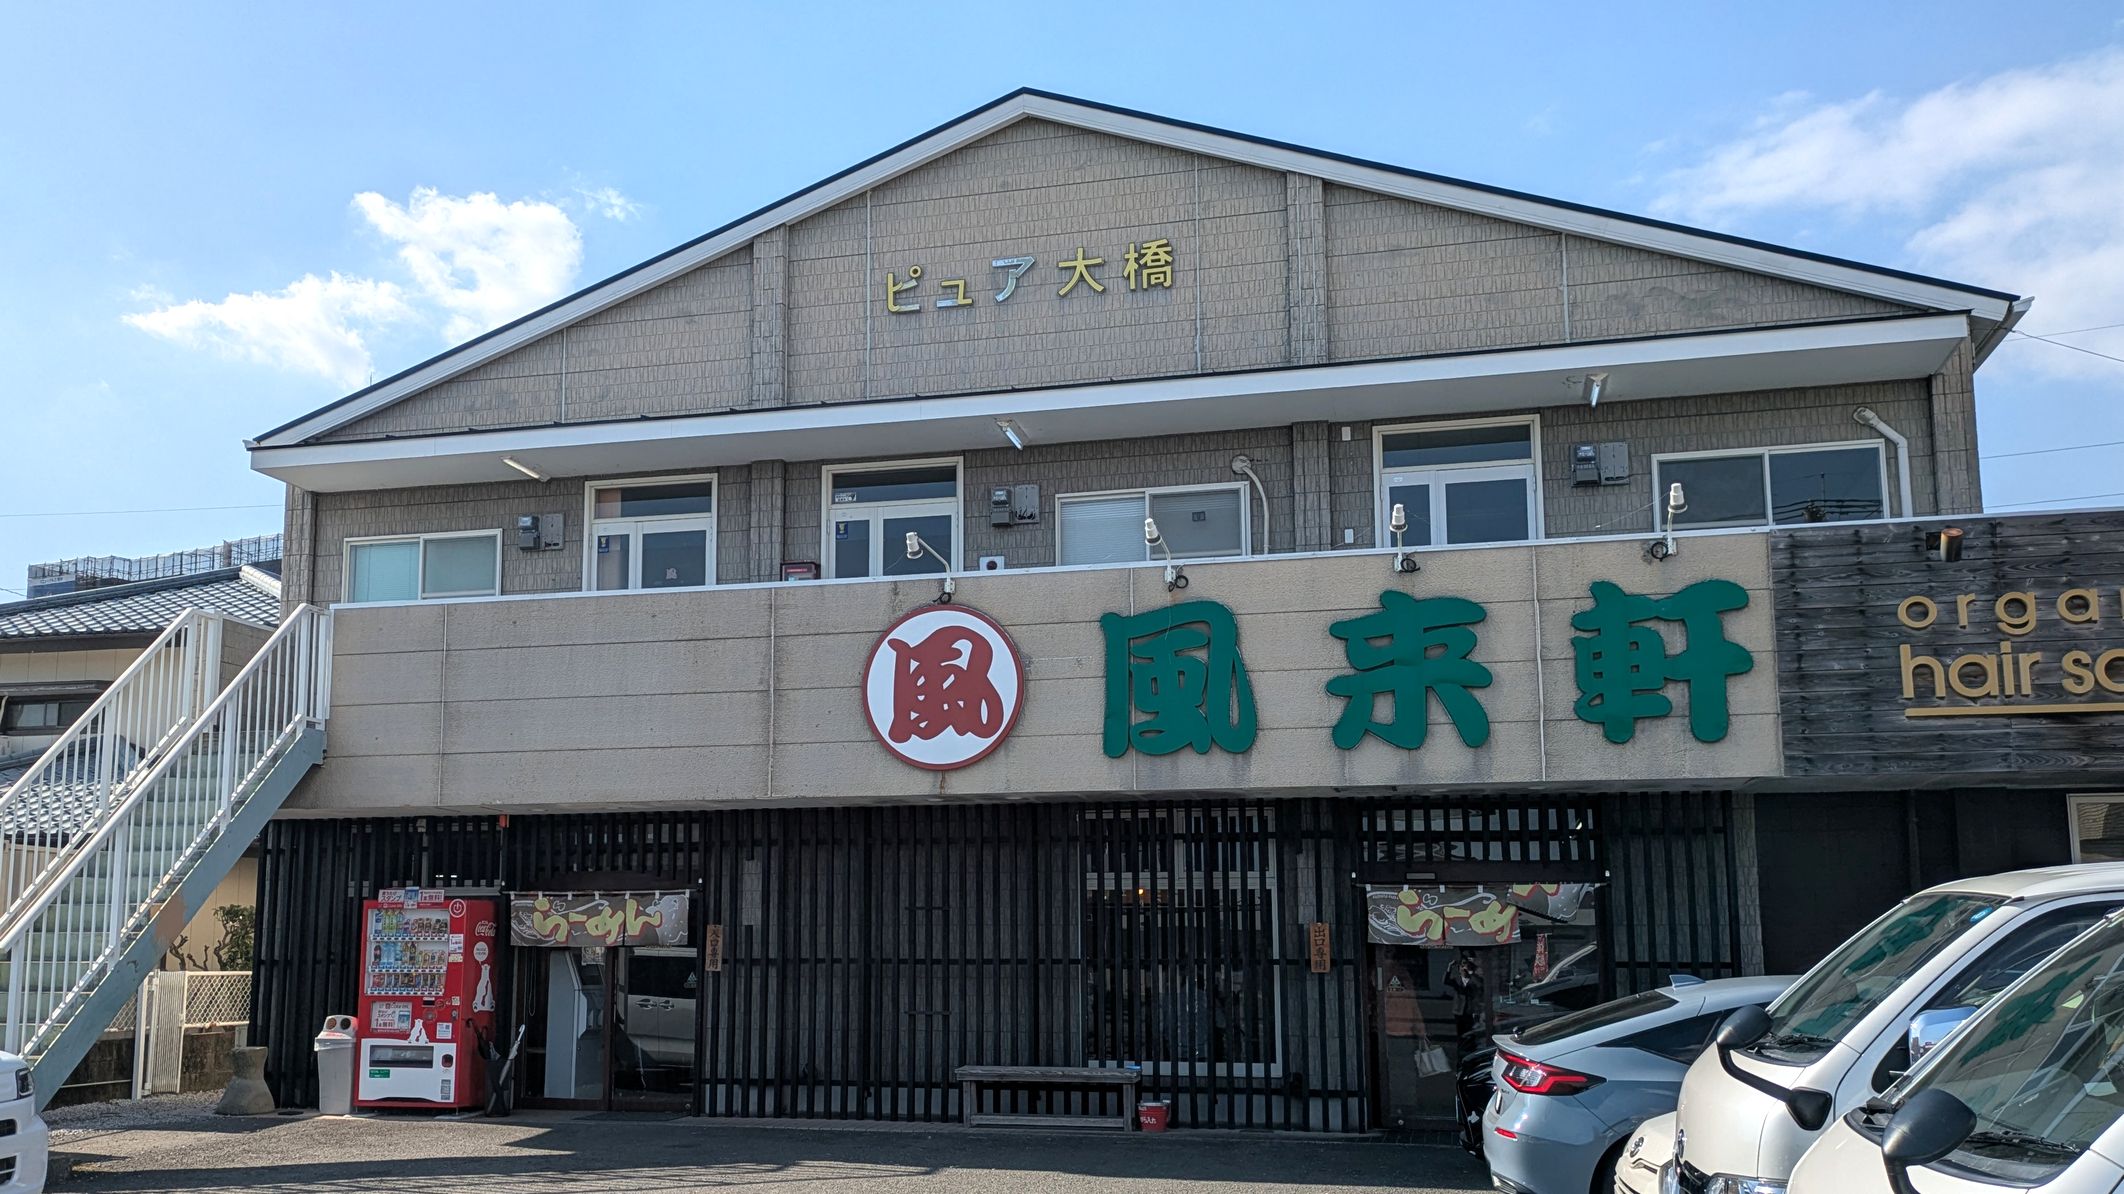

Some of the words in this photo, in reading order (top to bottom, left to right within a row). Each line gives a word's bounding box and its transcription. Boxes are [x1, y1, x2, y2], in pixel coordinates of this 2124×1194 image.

[887, 238, 1174, 314] ピュア大橋
[1896, 587, 2124, 636] orga
[1899, 640, 2042, 700] hair
[532, 897, 662, 945] らーめん
[708, 929, 721, 970] 入口専用
[1313, 926, 1327, 971] 出口専用
